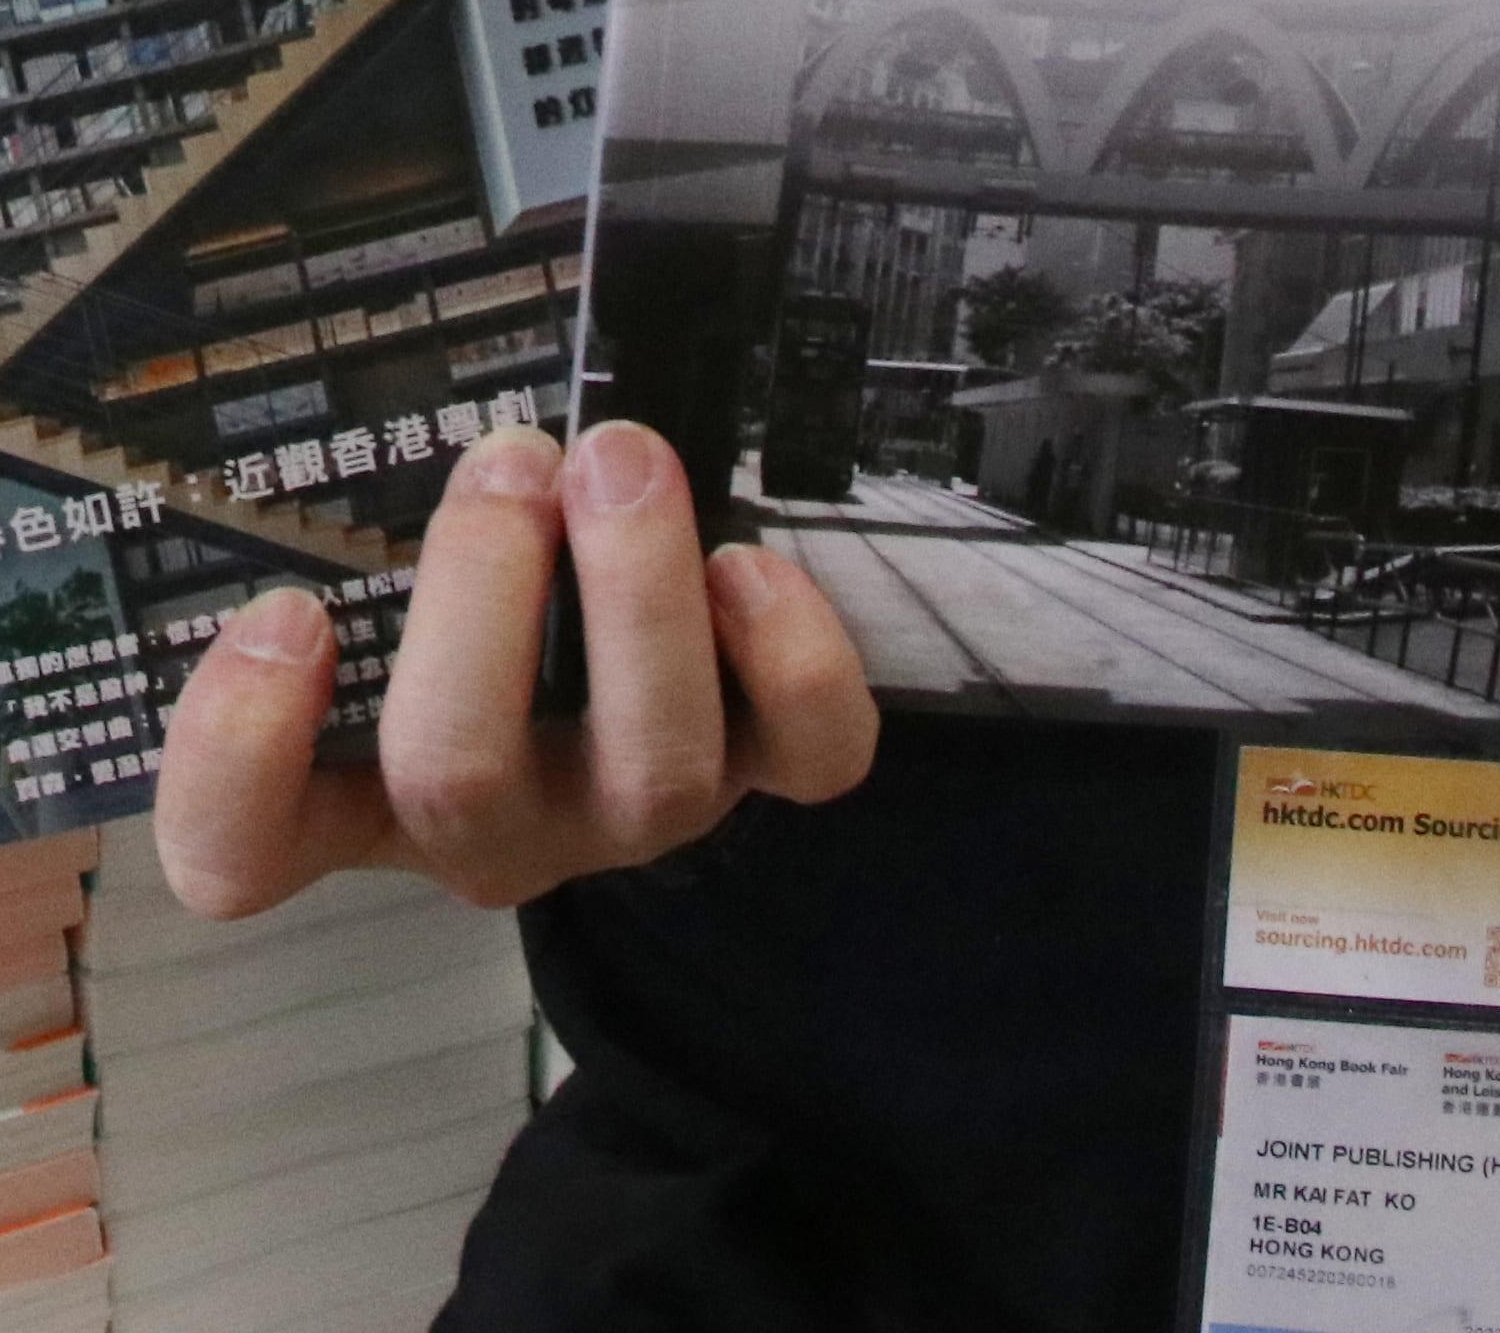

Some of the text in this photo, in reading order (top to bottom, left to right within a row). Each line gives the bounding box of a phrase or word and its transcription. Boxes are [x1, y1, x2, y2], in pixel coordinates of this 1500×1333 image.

[1262, 800, 1405, 835] hktdc.com
[1255, 908, 1320, 925] Visit now
[1254, 927, 1468, 961] sourcing.hktdc.com
[1256, 1054, 1410, 1076] Hong Kong Book Fair
[1442, 1066, 1481, 1083] Hong
[1441, 1084, 1469, 1097] and
[1256, 1139, 1325, 1163] JOINT
[1332, 1144, 1475, 1175] PUBLISHING
[1253, 1182, 1416, 1211] MR KAI FAT KO
[1252, 1215, 1323, 1236] 1E-B04
[1249, 1238, 1385, 1266] HONG KONG
